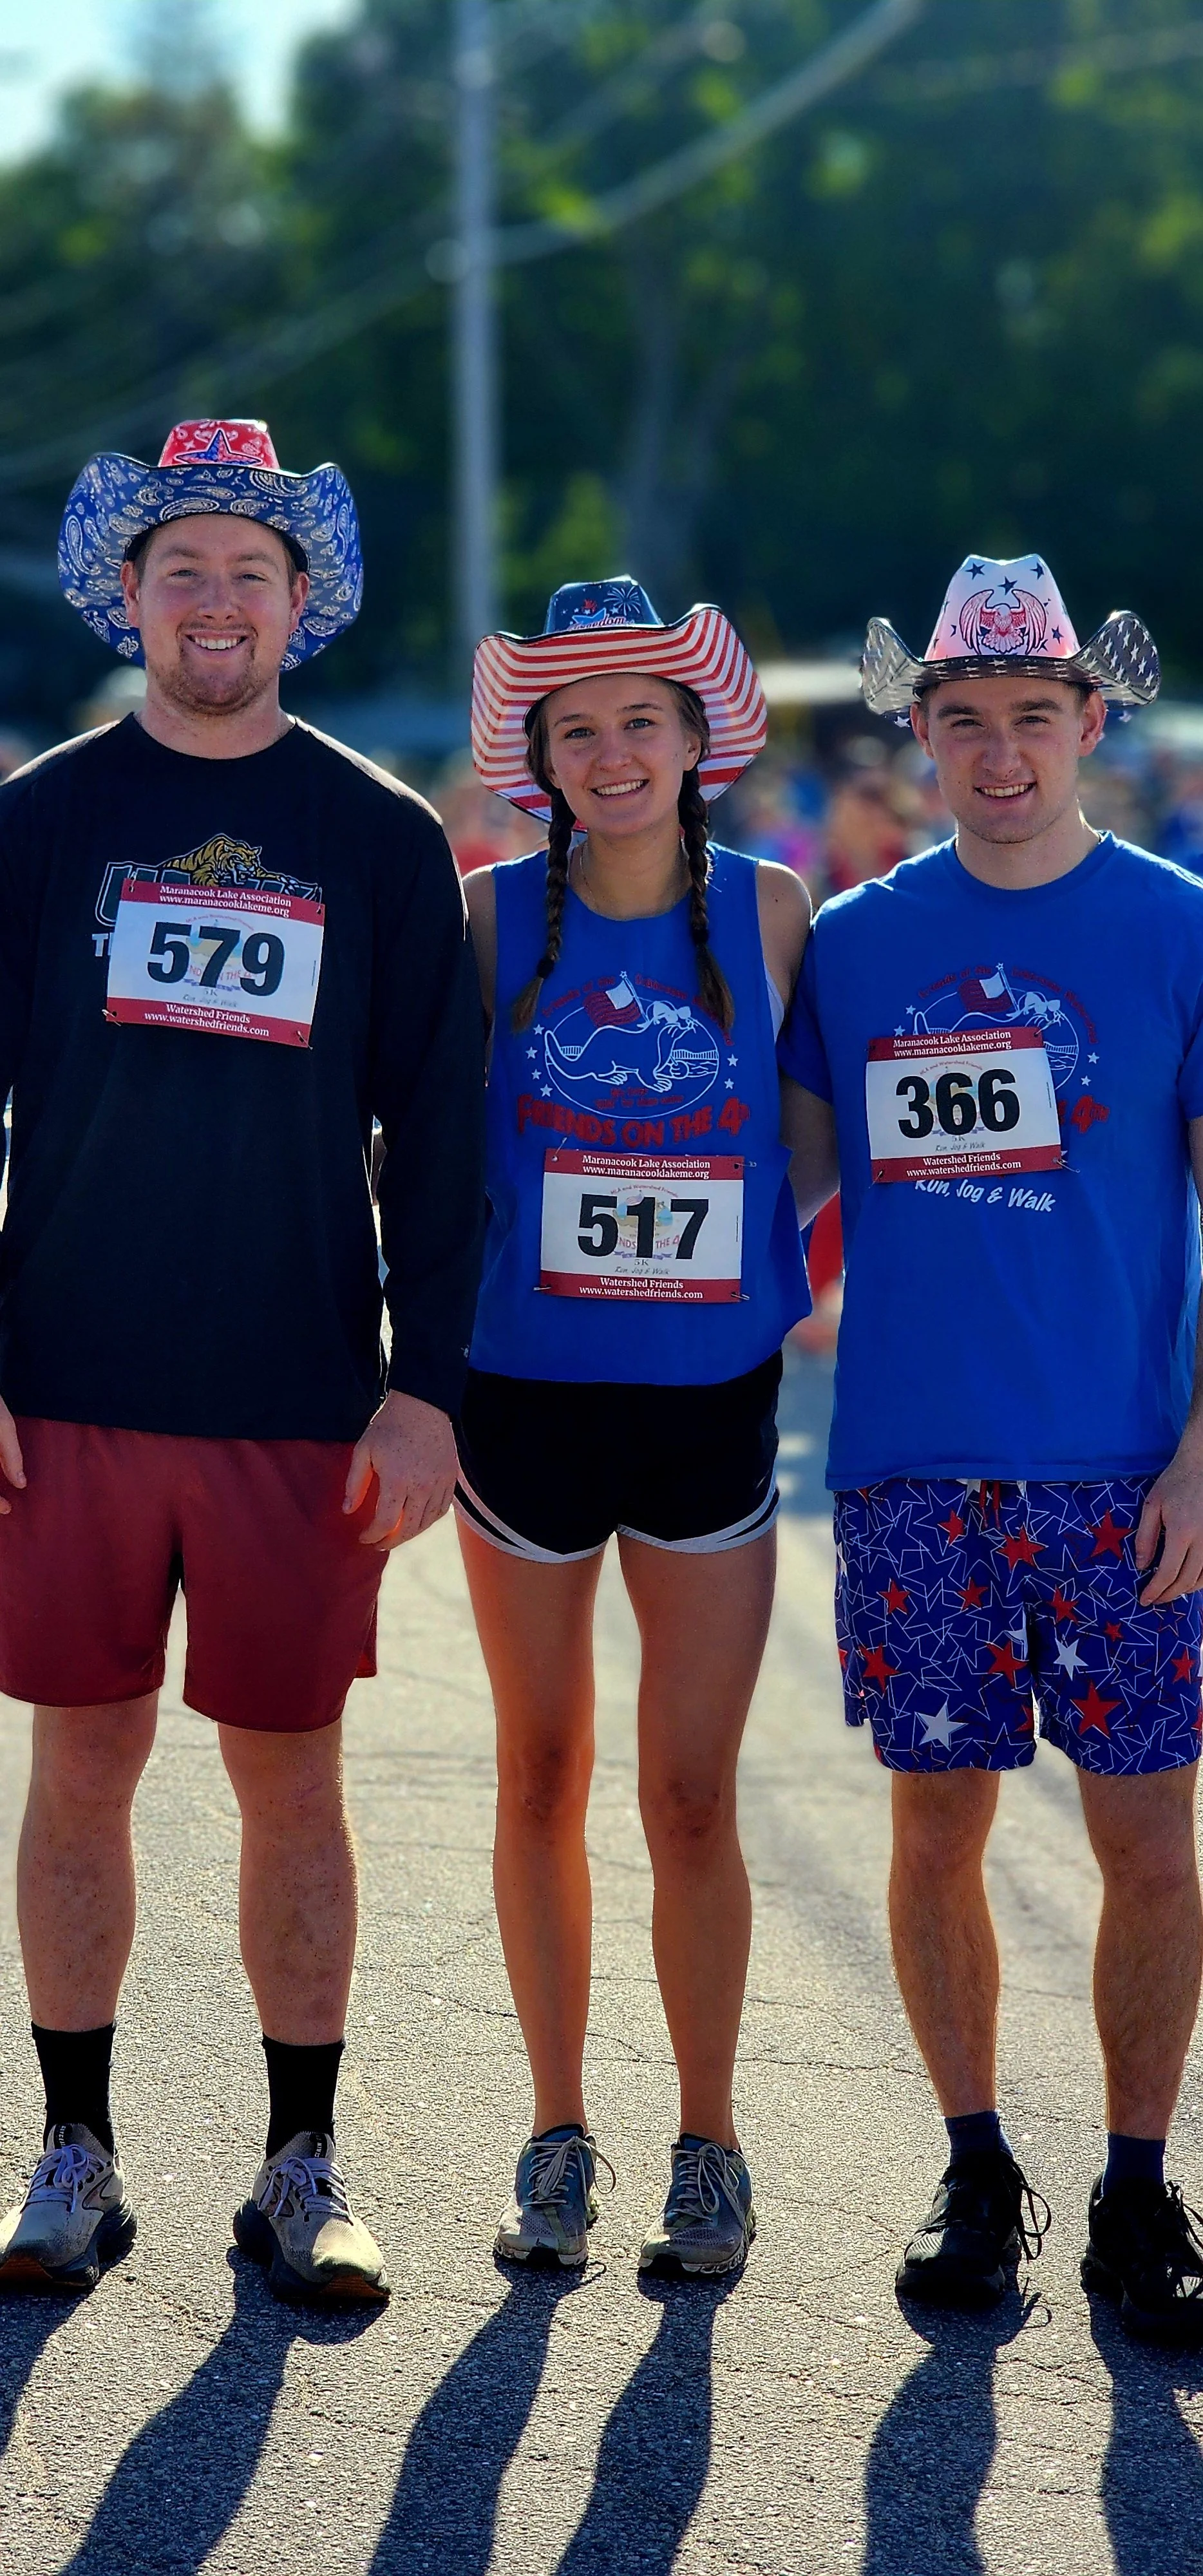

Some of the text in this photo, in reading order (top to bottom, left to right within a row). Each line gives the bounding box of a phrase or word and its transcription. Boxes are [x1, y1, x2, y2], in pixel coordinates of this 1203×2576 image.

[160, 886, 291, 907] Maranacook Lake Association
[160, 895, 290, 918] www.maranacooklakeme.org
[147, 922, 285, 996] 579
[166, 1003, 251, 1024] Watershed Friends
[144, 1012, 269, 1037] www.watershedfriends.com
[893, 1030, 1011, 1048] Maranacook Lake Association
[894, 1040, 1012, 1057] www.maranacooklakeme.org
[896, 1068, 1020, 1139] 366
[516, 1094, 616, 1146] FRIENDS
[621, 1120, 666, 1148] ON
[670, 1104, 713, 1143] THE
[582, 1155, 710, 1168] Maranacook Lake Association
[906, 1160, 1021, 1177] www.watershedfriends.com
[922, 1152, 1001, 1166] Watershed Friends
[583, 1166, 710, 1179] www.maranacooklakeme.org
[914, 1179, 1056, 1212] Run, Jog & Walk
[578, 1193, 709, 1260] 517
[655, 1237, 670, 1249] THE
[580, 1287, 703, 1298] www.watershedfriends.com
[600, 1277, 683, 1289] Watershed Friends
